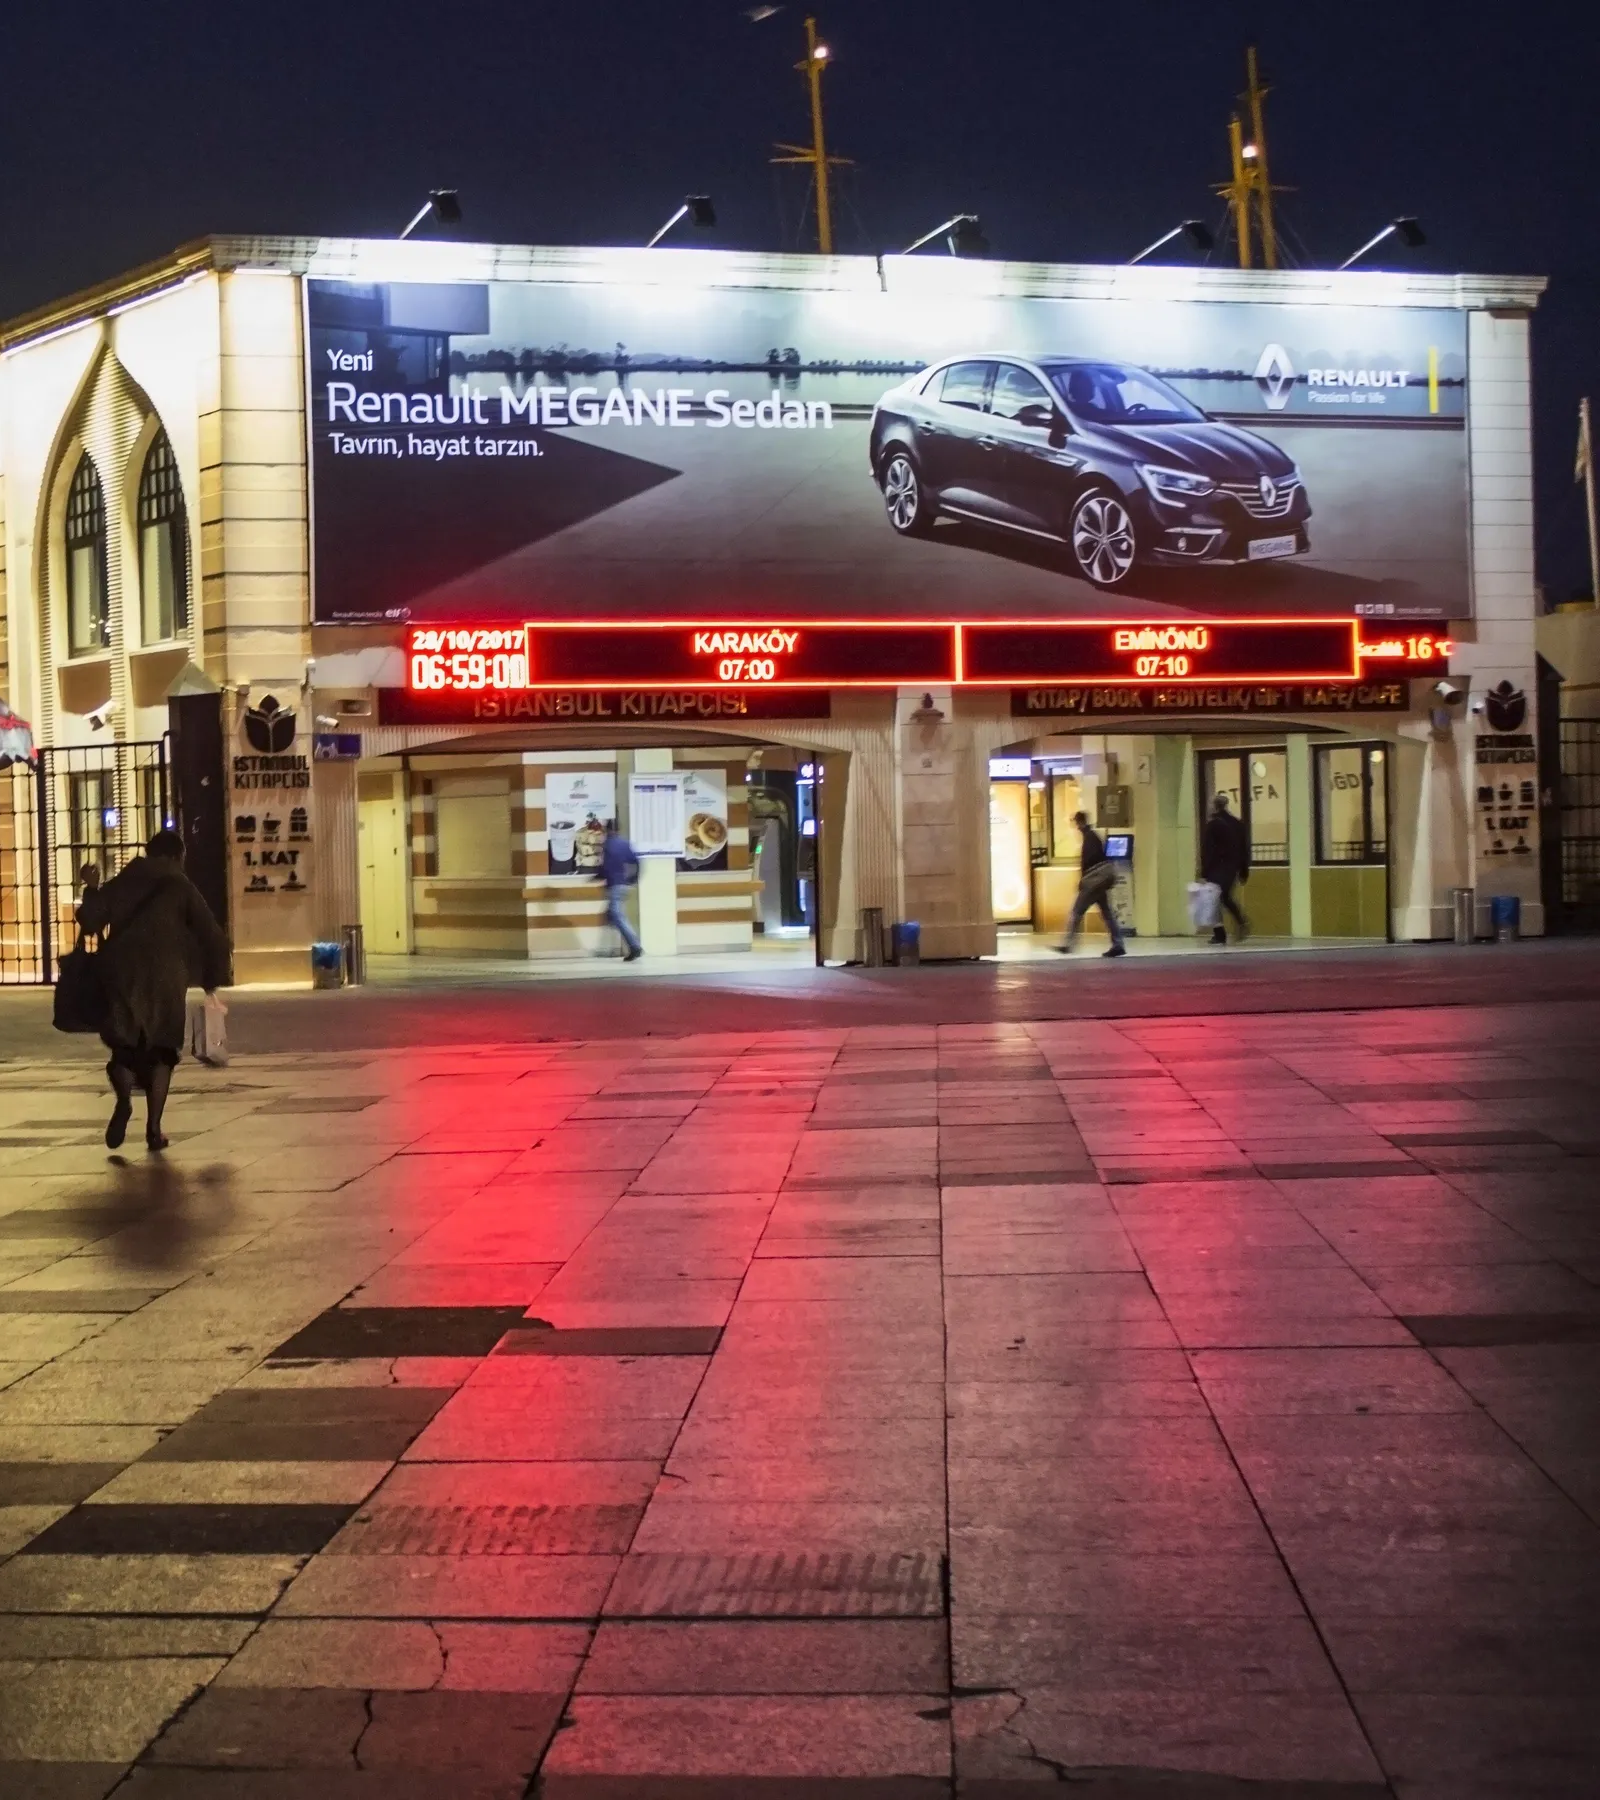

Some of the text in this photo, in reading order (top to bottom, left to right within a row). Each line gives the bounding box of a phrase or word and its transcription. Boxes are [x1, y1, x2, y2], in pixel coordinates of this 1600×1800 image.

[326, 349, 373, 373] Yeni
[1307, 368, 1410, 388] RENAULT
[327, 382, 834, 431] Renault MEGANE Sedan
[328, 433, 544, 462] Tavrın, hayat tarzın.
[412, 630, 524, 652] 28/10/2017
[694, 629, 798, 653] KARAKÖY
[1406, 637, 1432, 659] 16
[719, 659, 775, 680] 07:00
[1136, 656, 1188, 676] 07:10
[244, 850, 300, 866] 1. KAT
